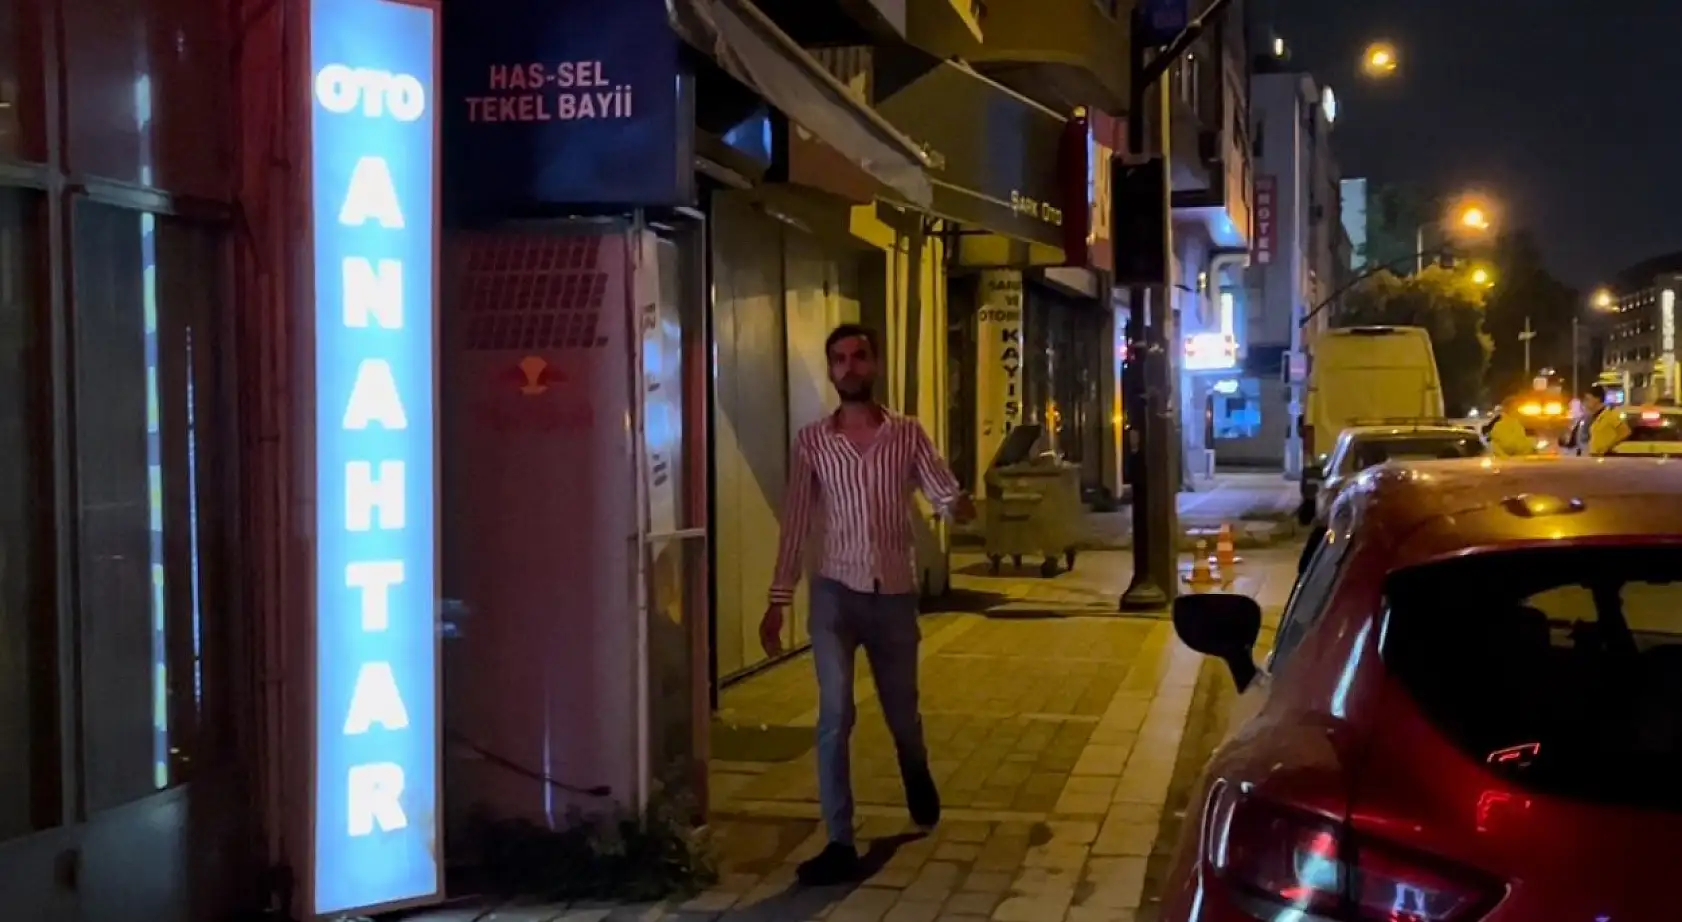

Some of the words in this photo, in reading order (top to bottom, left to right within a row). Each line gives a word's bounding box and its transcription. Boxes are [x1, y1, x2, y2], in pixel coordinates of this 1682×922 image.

[315, 63, 424, 121] OTO
[489, 61, 610, 90] HAS-SEL
[465, 94, 551, 122] TEKEL
[338, 156, 409, 837] ANAHTAR
